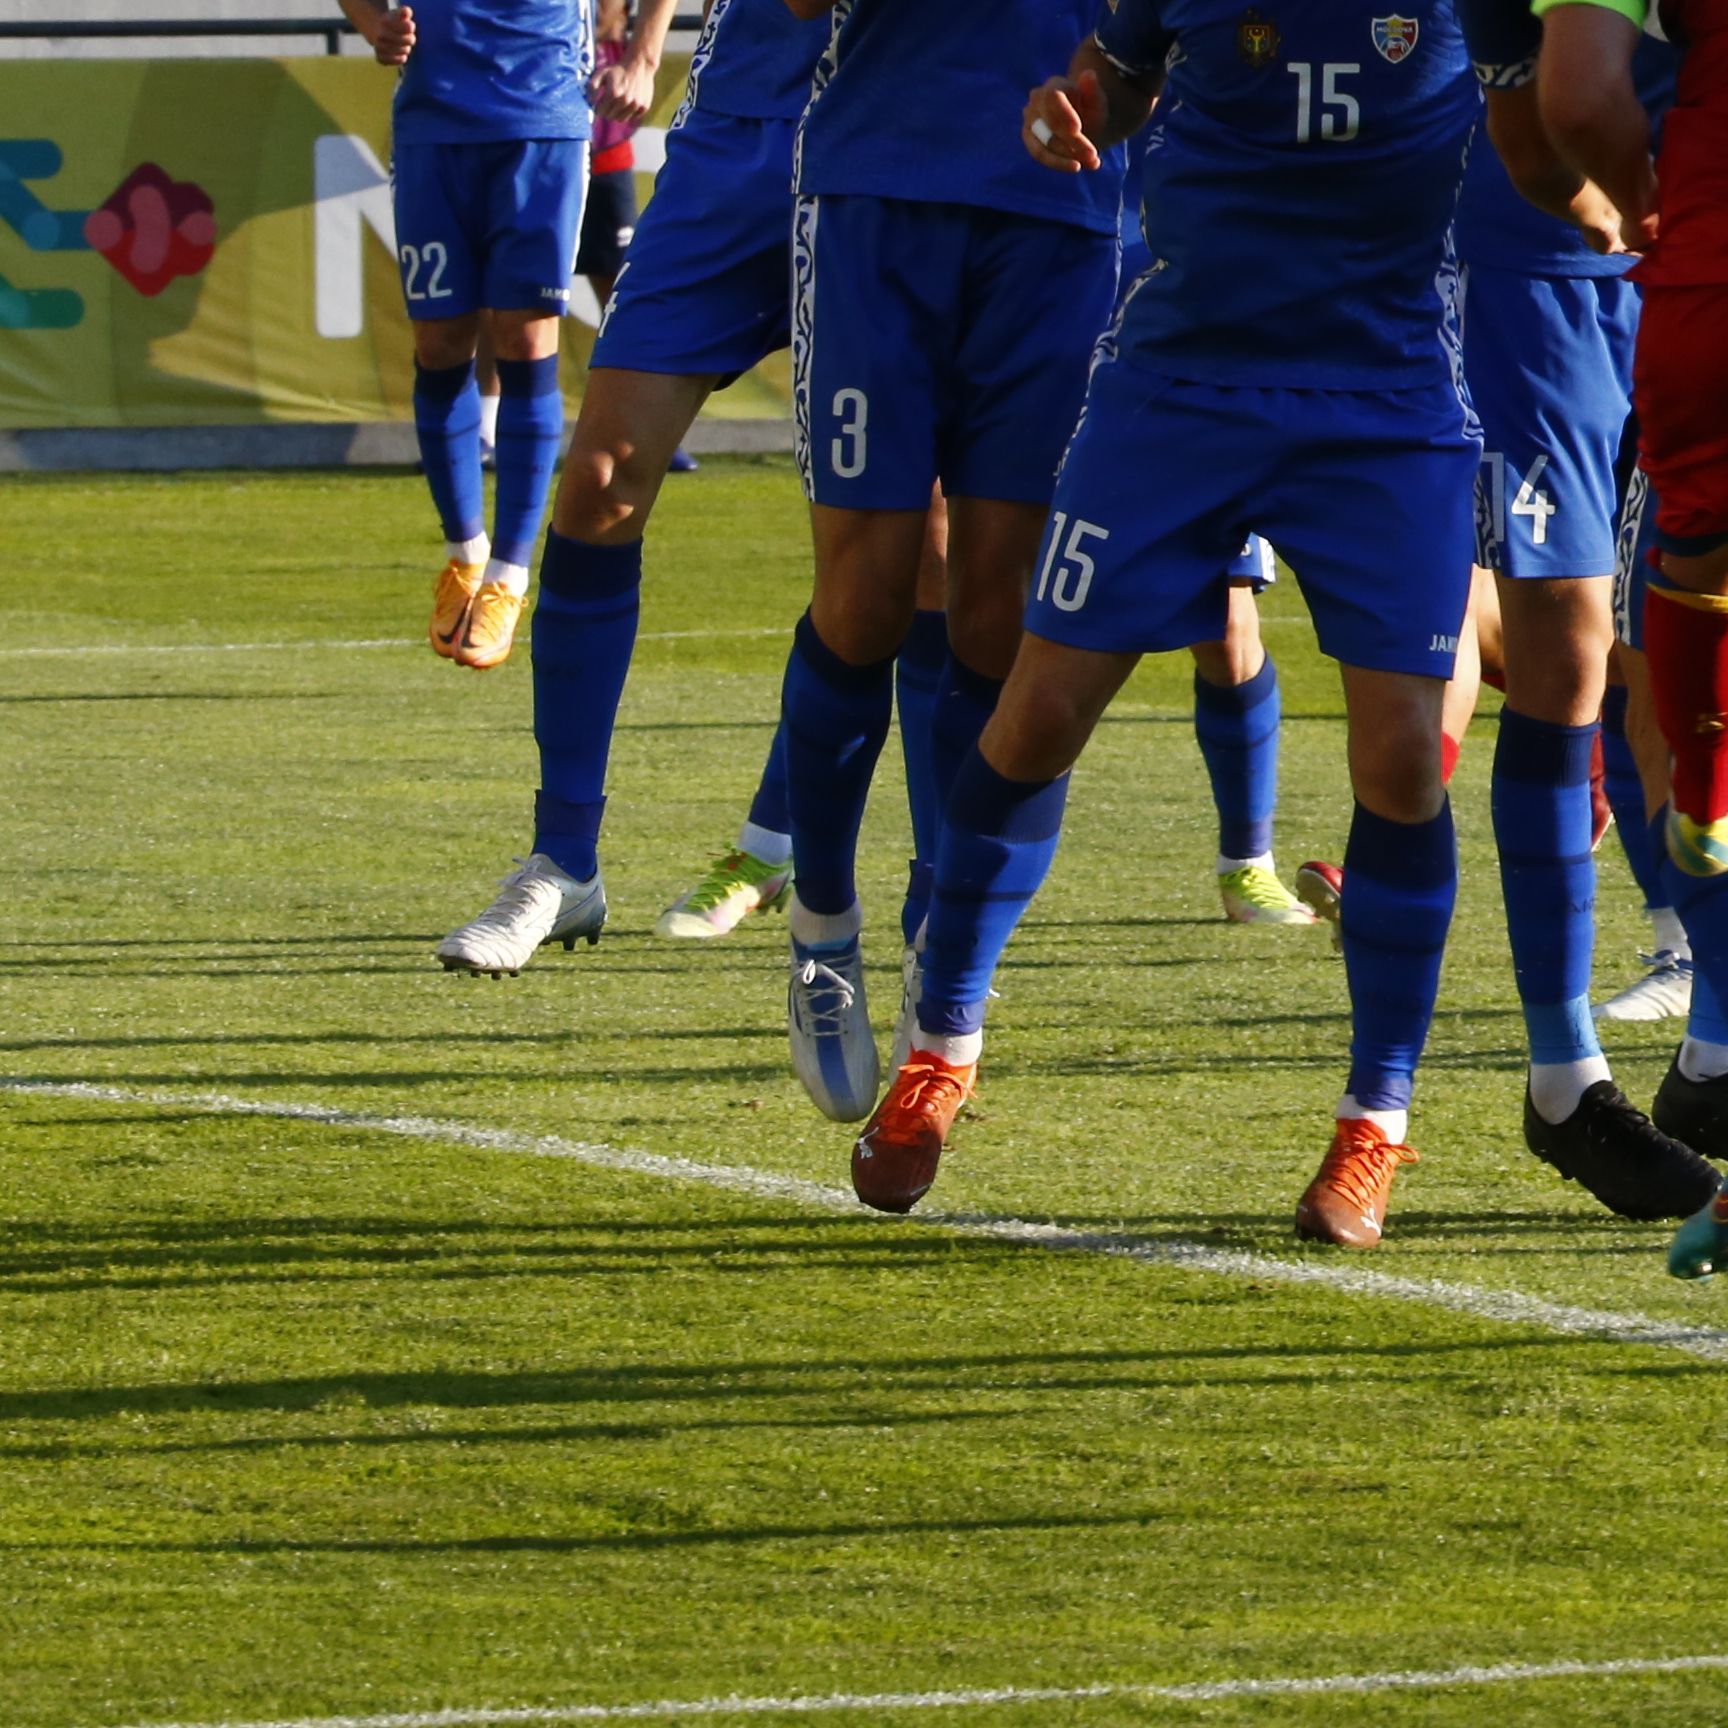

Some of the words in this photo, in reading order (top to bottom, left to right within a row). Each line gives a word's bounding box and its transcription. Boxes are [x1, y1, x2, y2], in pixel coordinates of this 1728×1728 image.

[1287, 62, 1361, 143] 15
[401, 241, 453, 301] 22
[831, 387, 868, 479] 3
[1480, 451, 1556, 544] 14
[1036, 511, 1110, 612] 15
